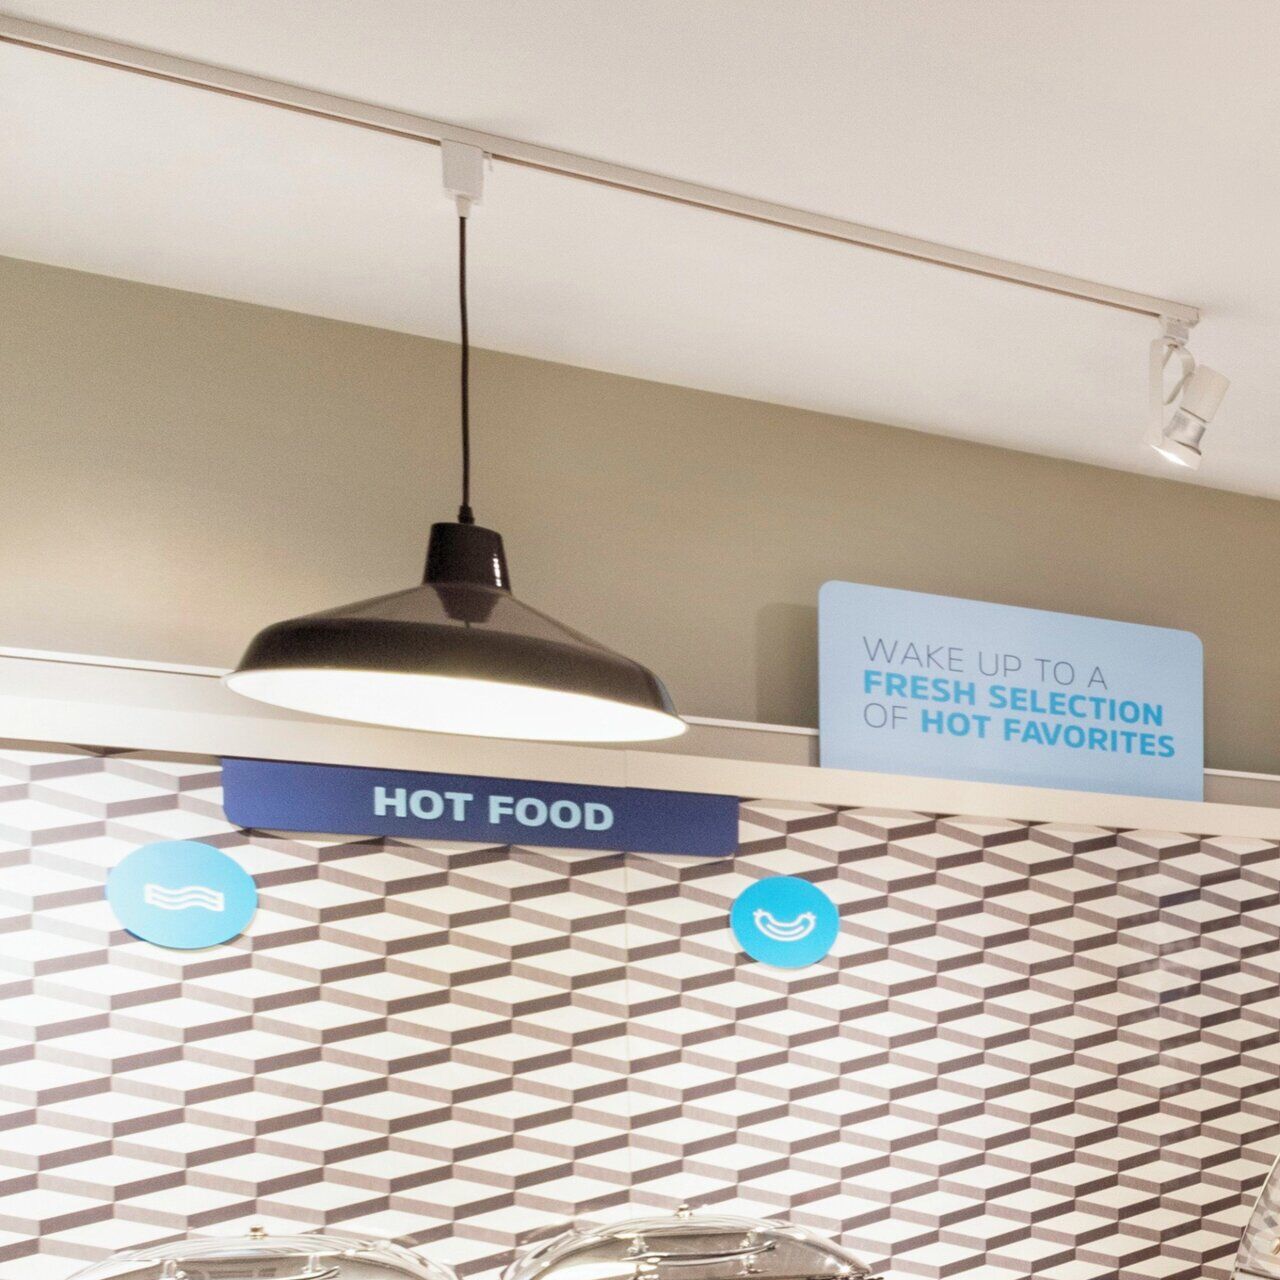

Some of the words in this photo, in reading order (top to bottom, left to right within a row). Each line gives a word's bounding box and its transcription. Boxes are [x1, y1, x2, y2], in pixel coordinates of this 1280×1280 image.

[862, 635, 964, 673] WAKE
[978, 651, 1022, 678] UP
[1034, 657, 1075, 686] TO
[1087, 666, 1108, 690] A
[863, 669, 976, 706] FRESH
[988, 684, 1163, 727] SELECTION
[863, 702, 909, 730] OF
[920, 708, 991, 739] HOT
[1003, 718, 1176, 758] FAVORITES
[373, 786, 474, 822] HOT
[488, 794, 615, 831] FOOD
